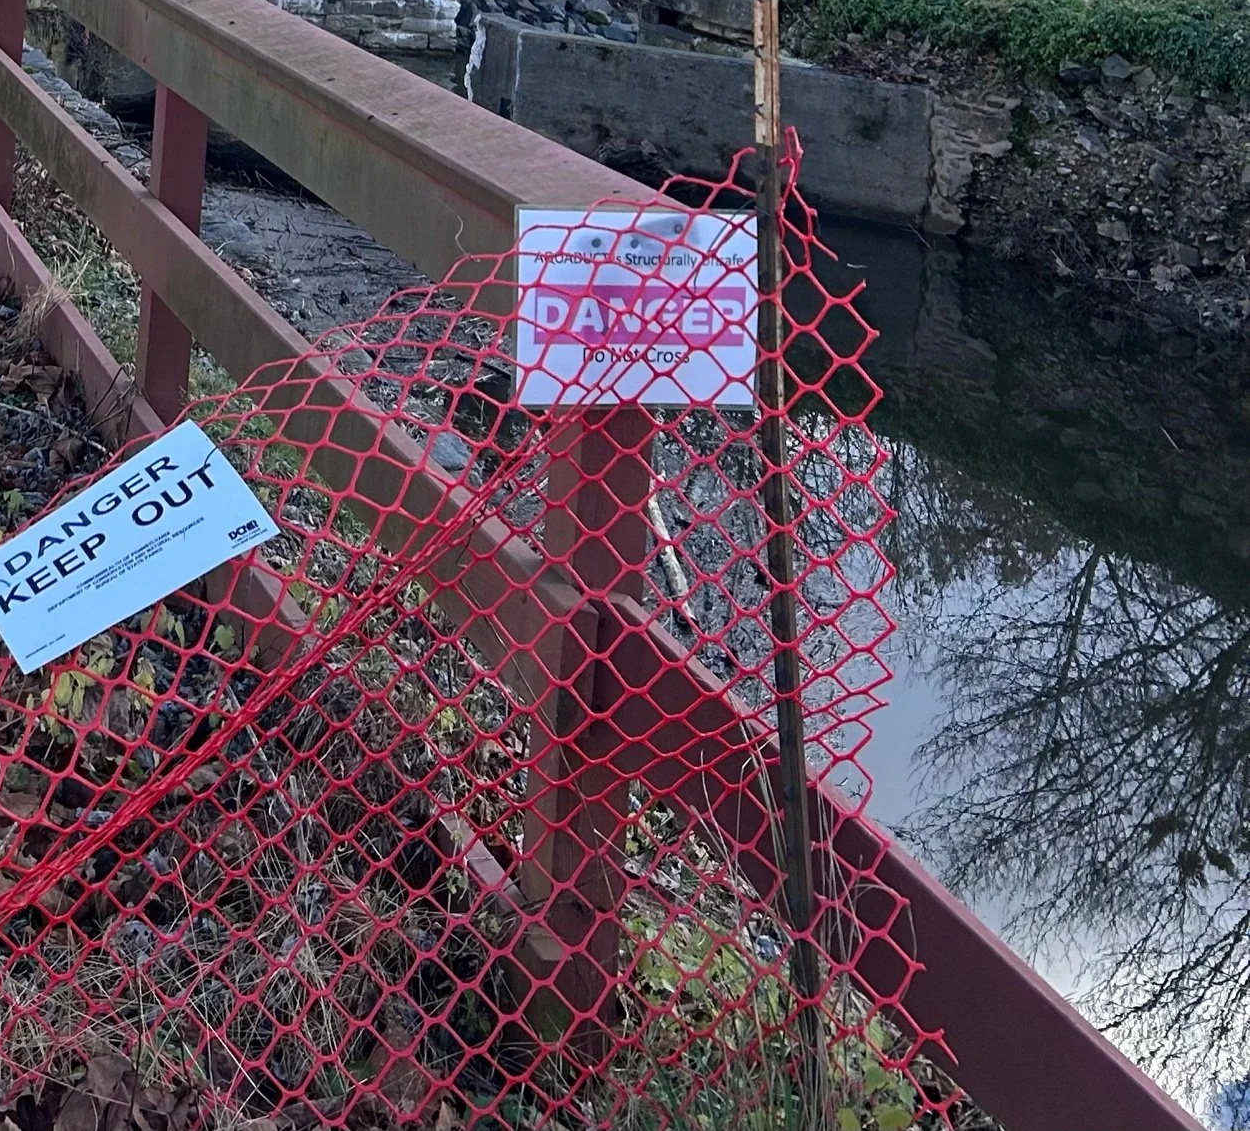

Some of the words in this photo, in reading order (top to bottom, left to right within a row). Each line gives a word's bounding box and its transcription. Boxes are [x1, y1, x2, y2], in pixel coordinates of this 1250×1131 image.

[537, 296, 746, 335] DANGER
[583, 347, 605, 363] Do
[645, 347, 690, 363] Cross
[3, 456, 179, 576] DANGER
[131, 463, 216, 527] OUT
